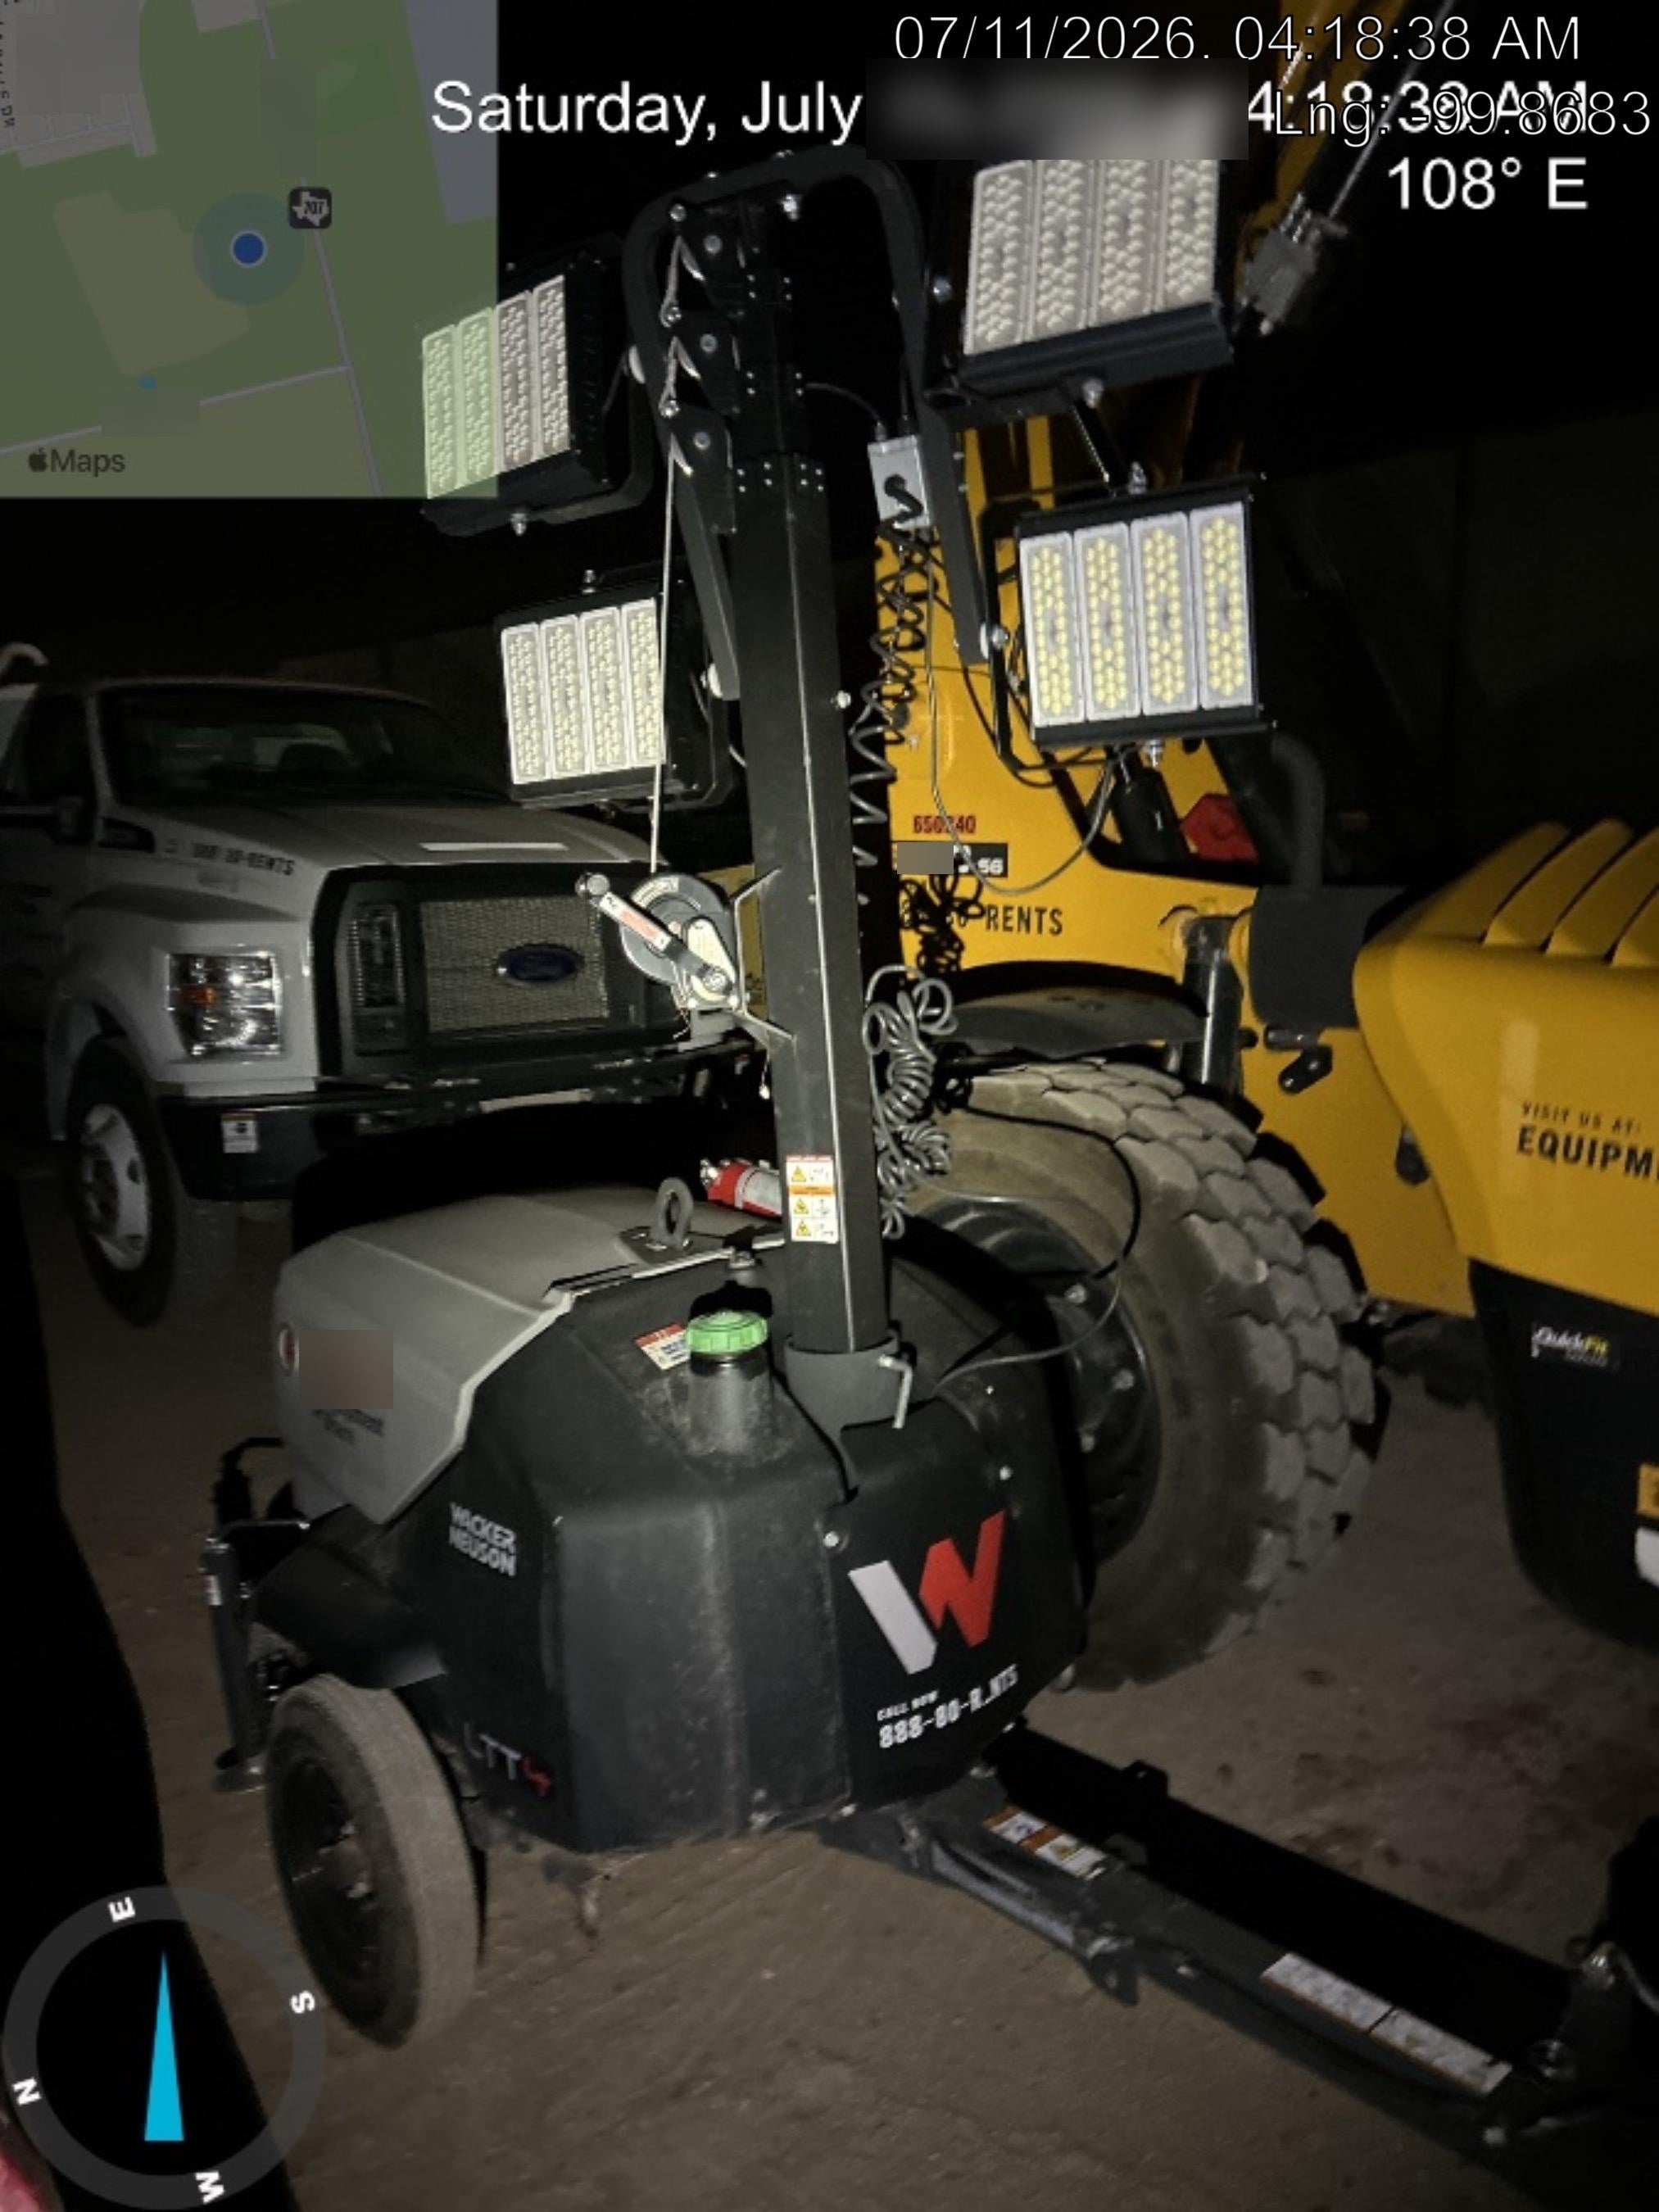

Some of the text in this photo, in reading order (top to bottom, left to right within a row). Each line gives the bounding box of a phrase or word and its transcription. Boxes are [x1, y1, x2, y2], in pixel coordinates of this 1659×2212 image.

[1516, 1123, 1659, 1184] EQUIPM
[448, 1525, 516, 1576] NEUSON
[449, 1501, 516, 1554] WACKER
